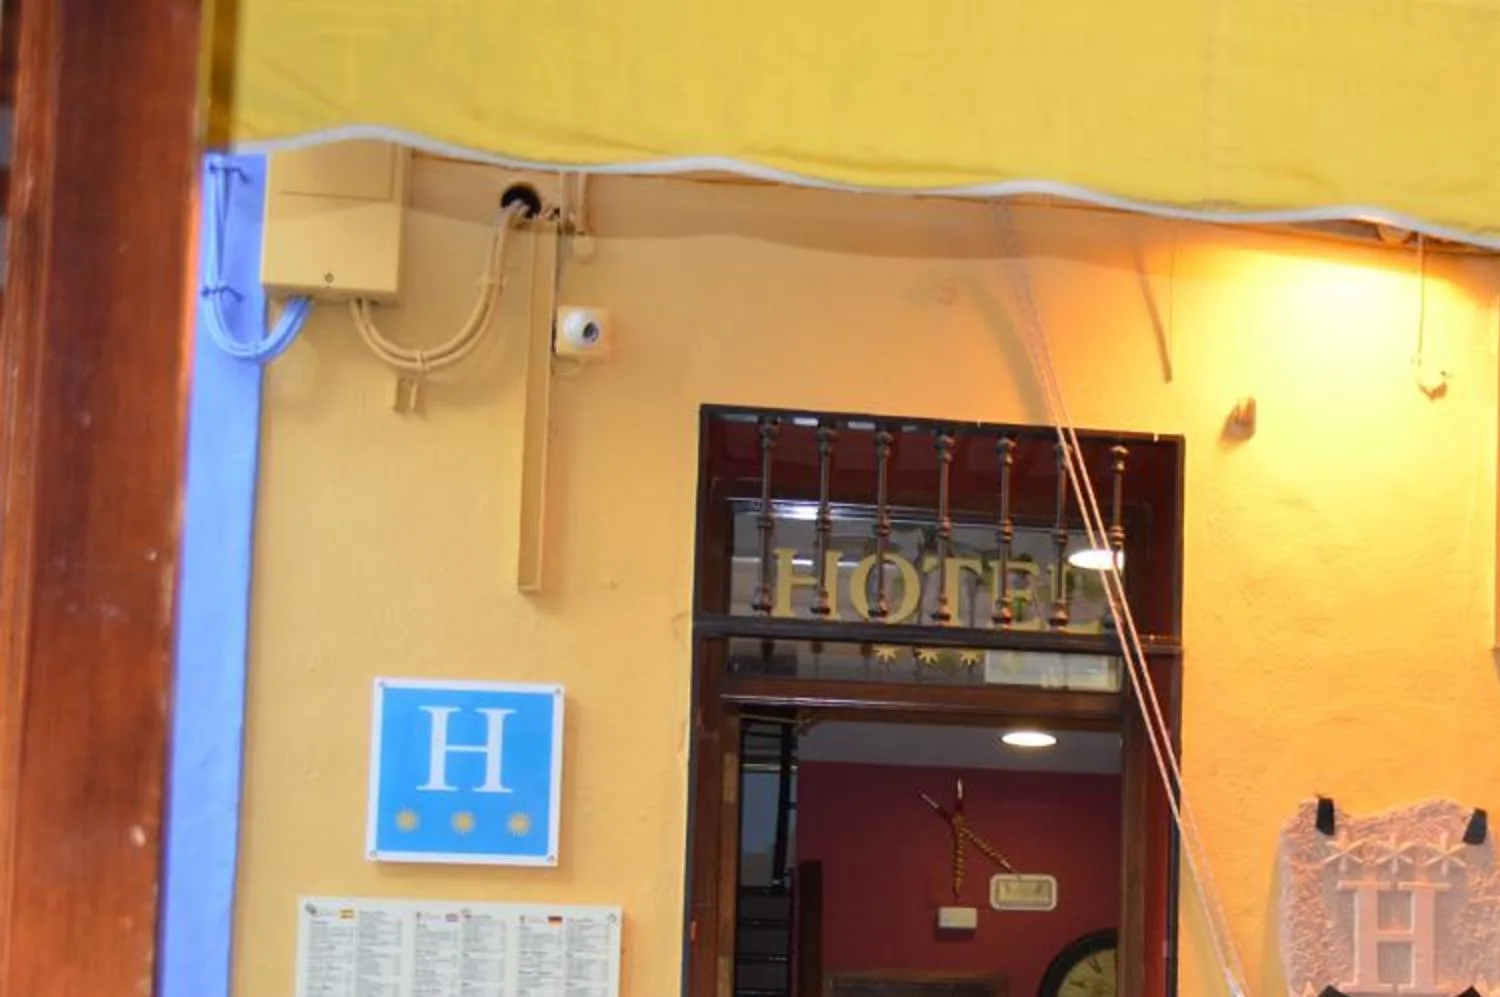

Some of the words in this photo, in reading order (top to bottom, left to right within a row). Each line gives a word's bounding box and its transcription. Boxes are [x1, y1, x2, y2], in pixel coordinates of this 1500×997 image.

[772, 548, 1099, 633] HOTEL
[416, 705, 516, 793] H
[1336, 880, 1451, 994] H
